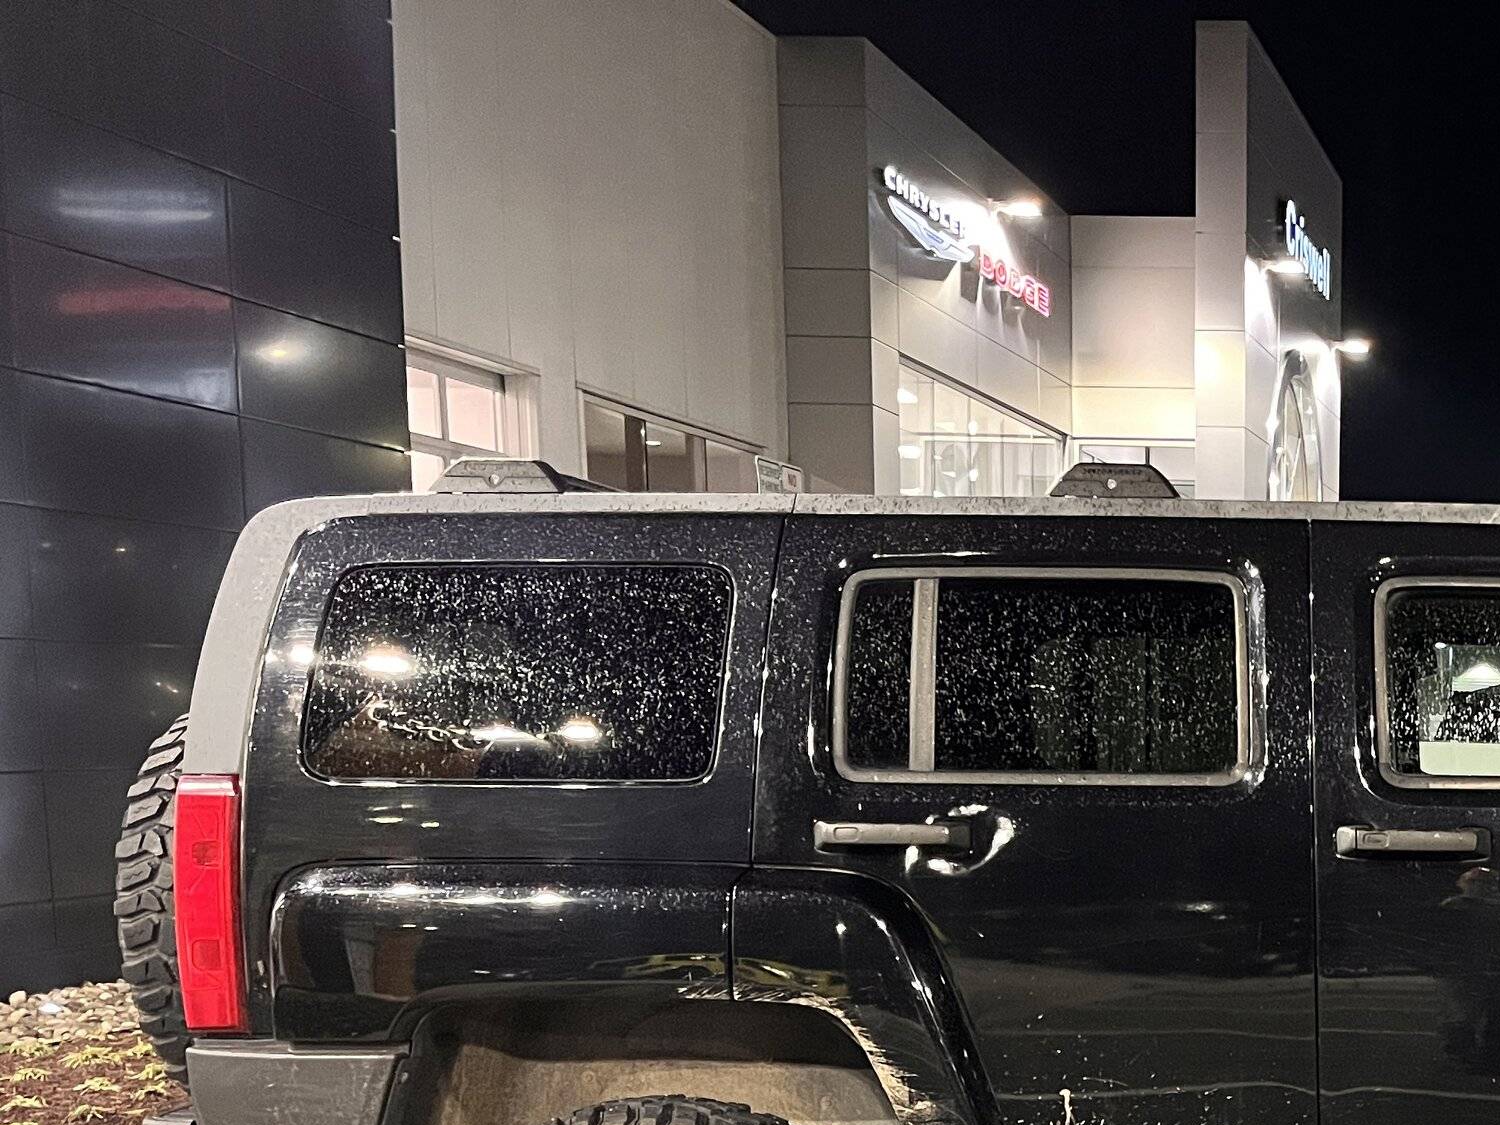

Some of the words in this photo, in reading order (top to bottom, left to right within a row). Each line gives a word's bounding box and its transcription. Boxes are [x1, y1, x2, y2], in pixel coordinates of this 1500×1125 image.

[884, 165, 968, 240] CHRYSLE
[979, 248, 1051, 318] DODGE
[1285, 199, 1331, 301] Criswell
